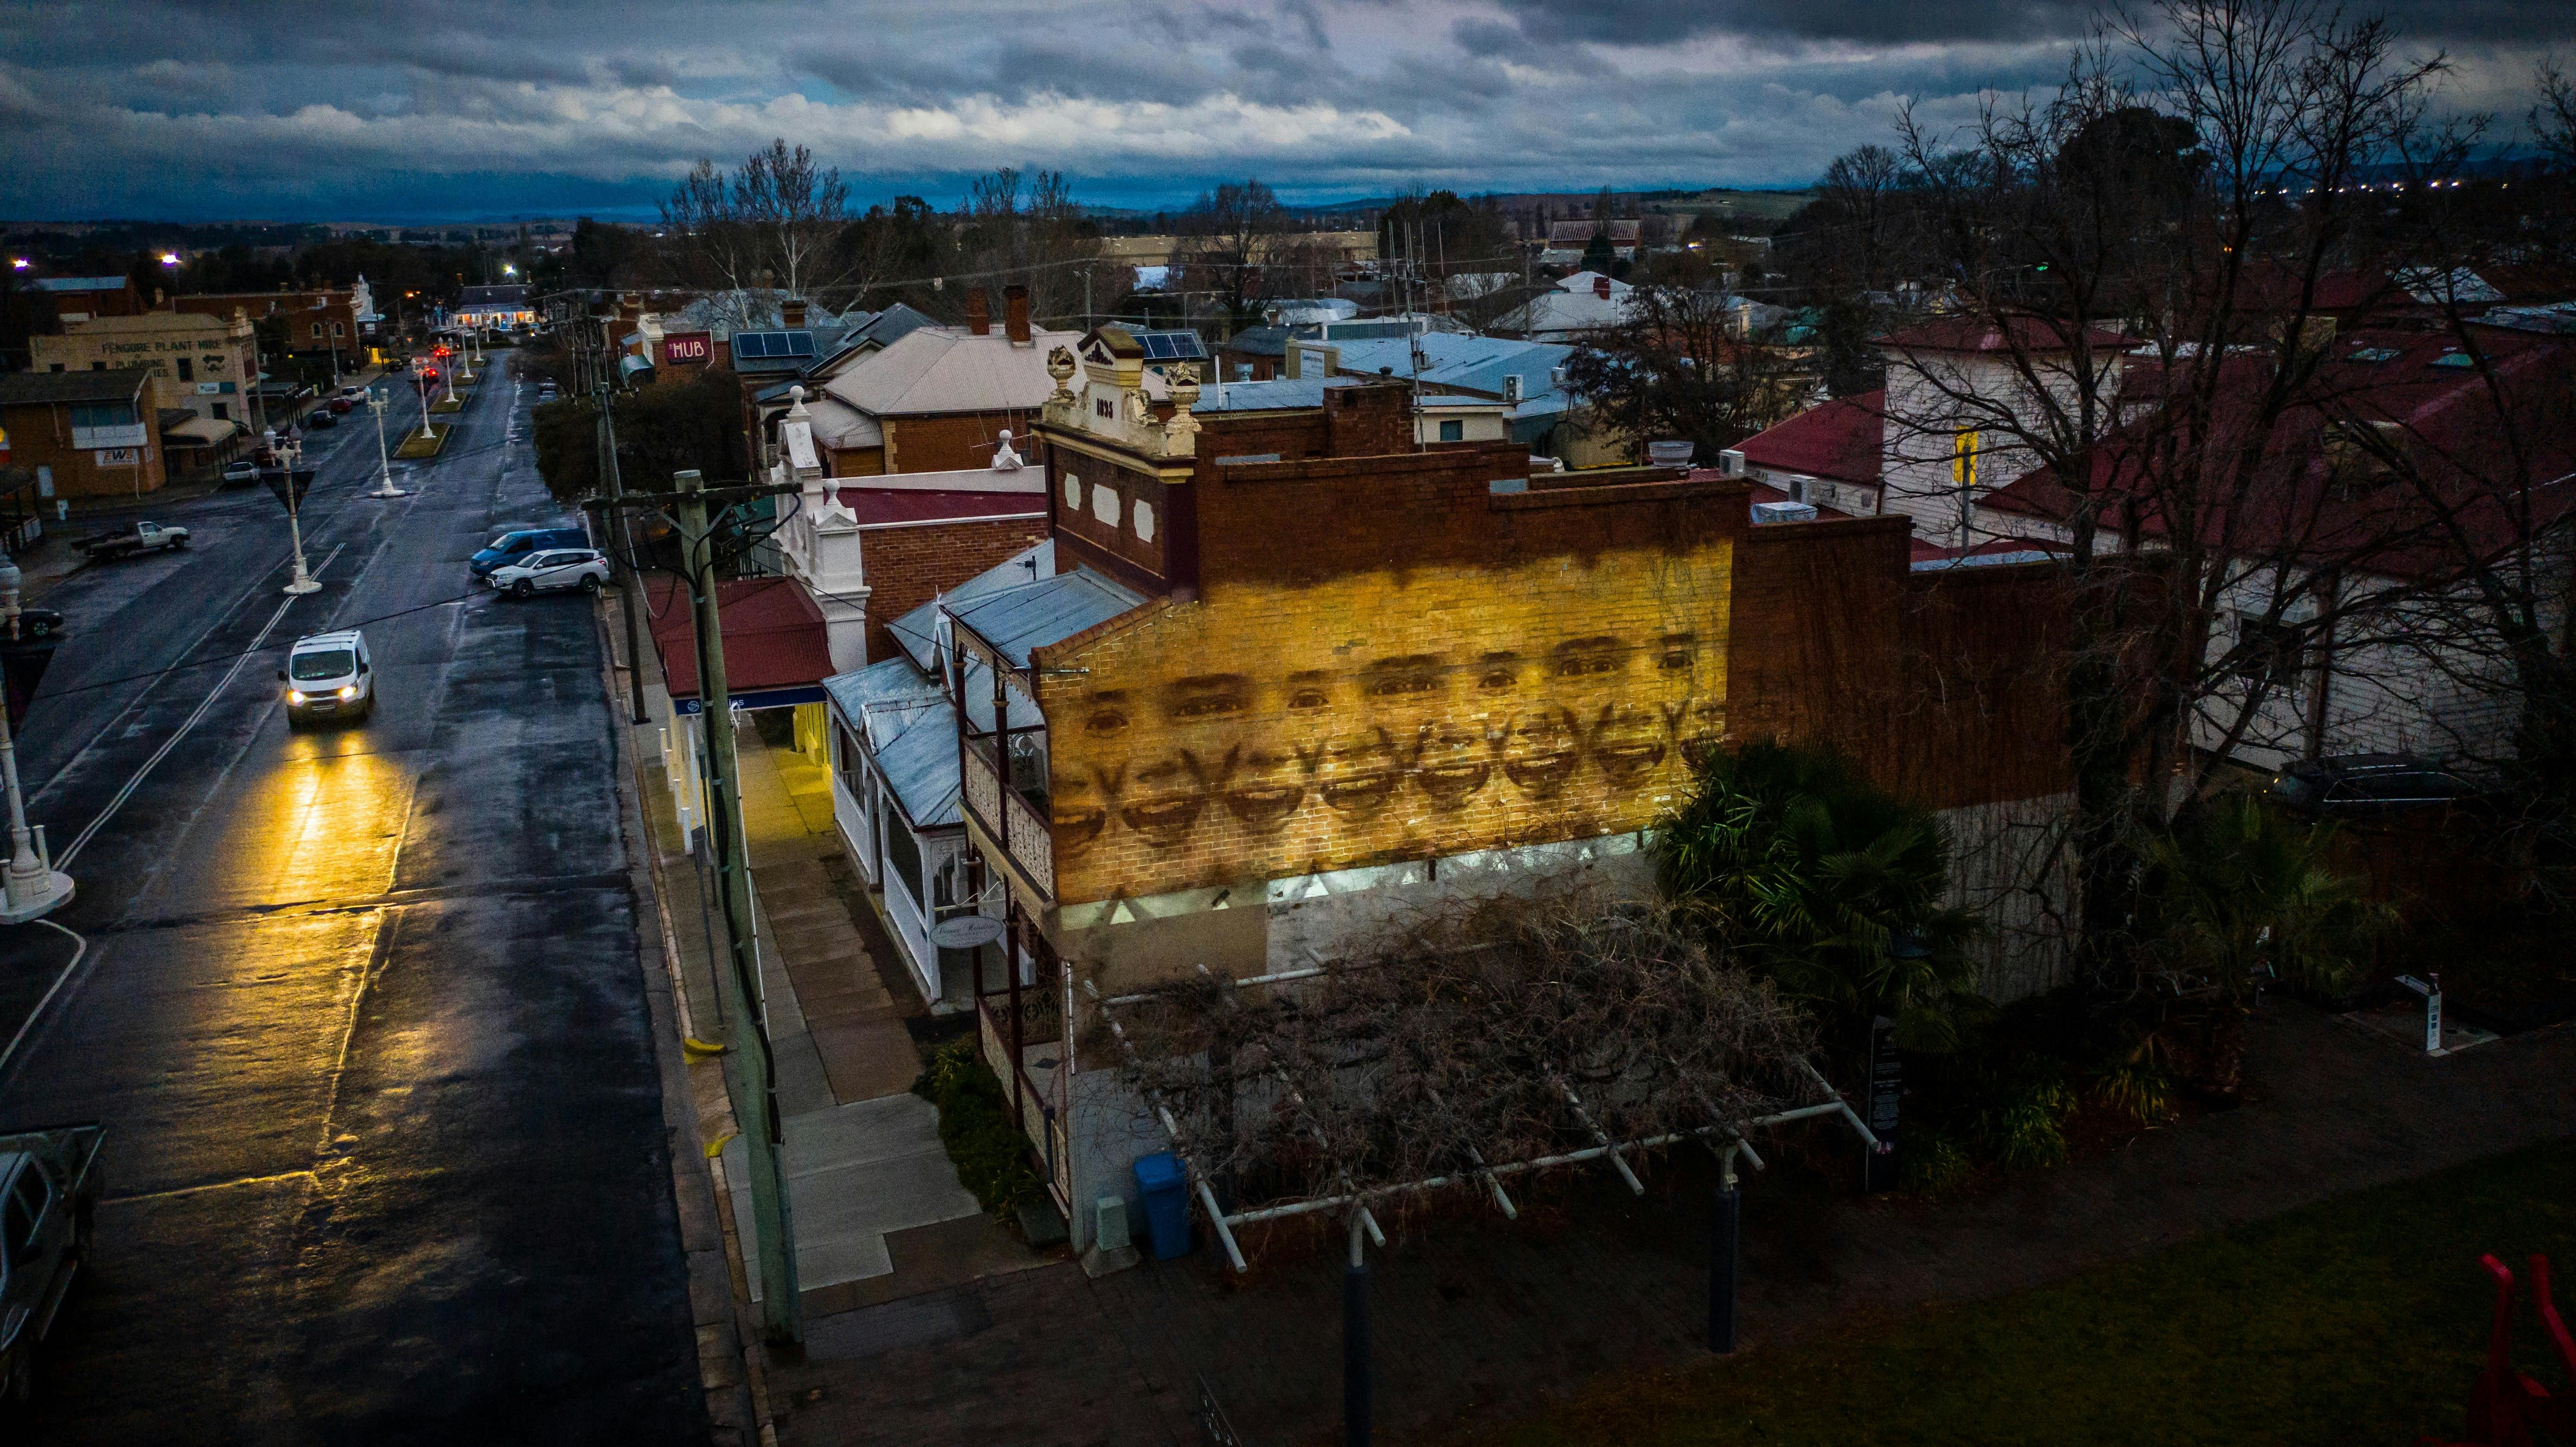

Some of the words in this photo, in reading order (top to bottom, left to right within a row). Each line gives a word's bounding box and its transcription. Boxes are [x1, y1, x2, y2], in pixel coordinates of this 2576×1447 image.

[155, 340, 191, 352] PLANT
[198, 340, 222, 350] HIRE
[673, 341, 704, 358] HUB
[116, 359, 165, 368] PLUMBING
[1097, 398, 1113, 419] 1895
